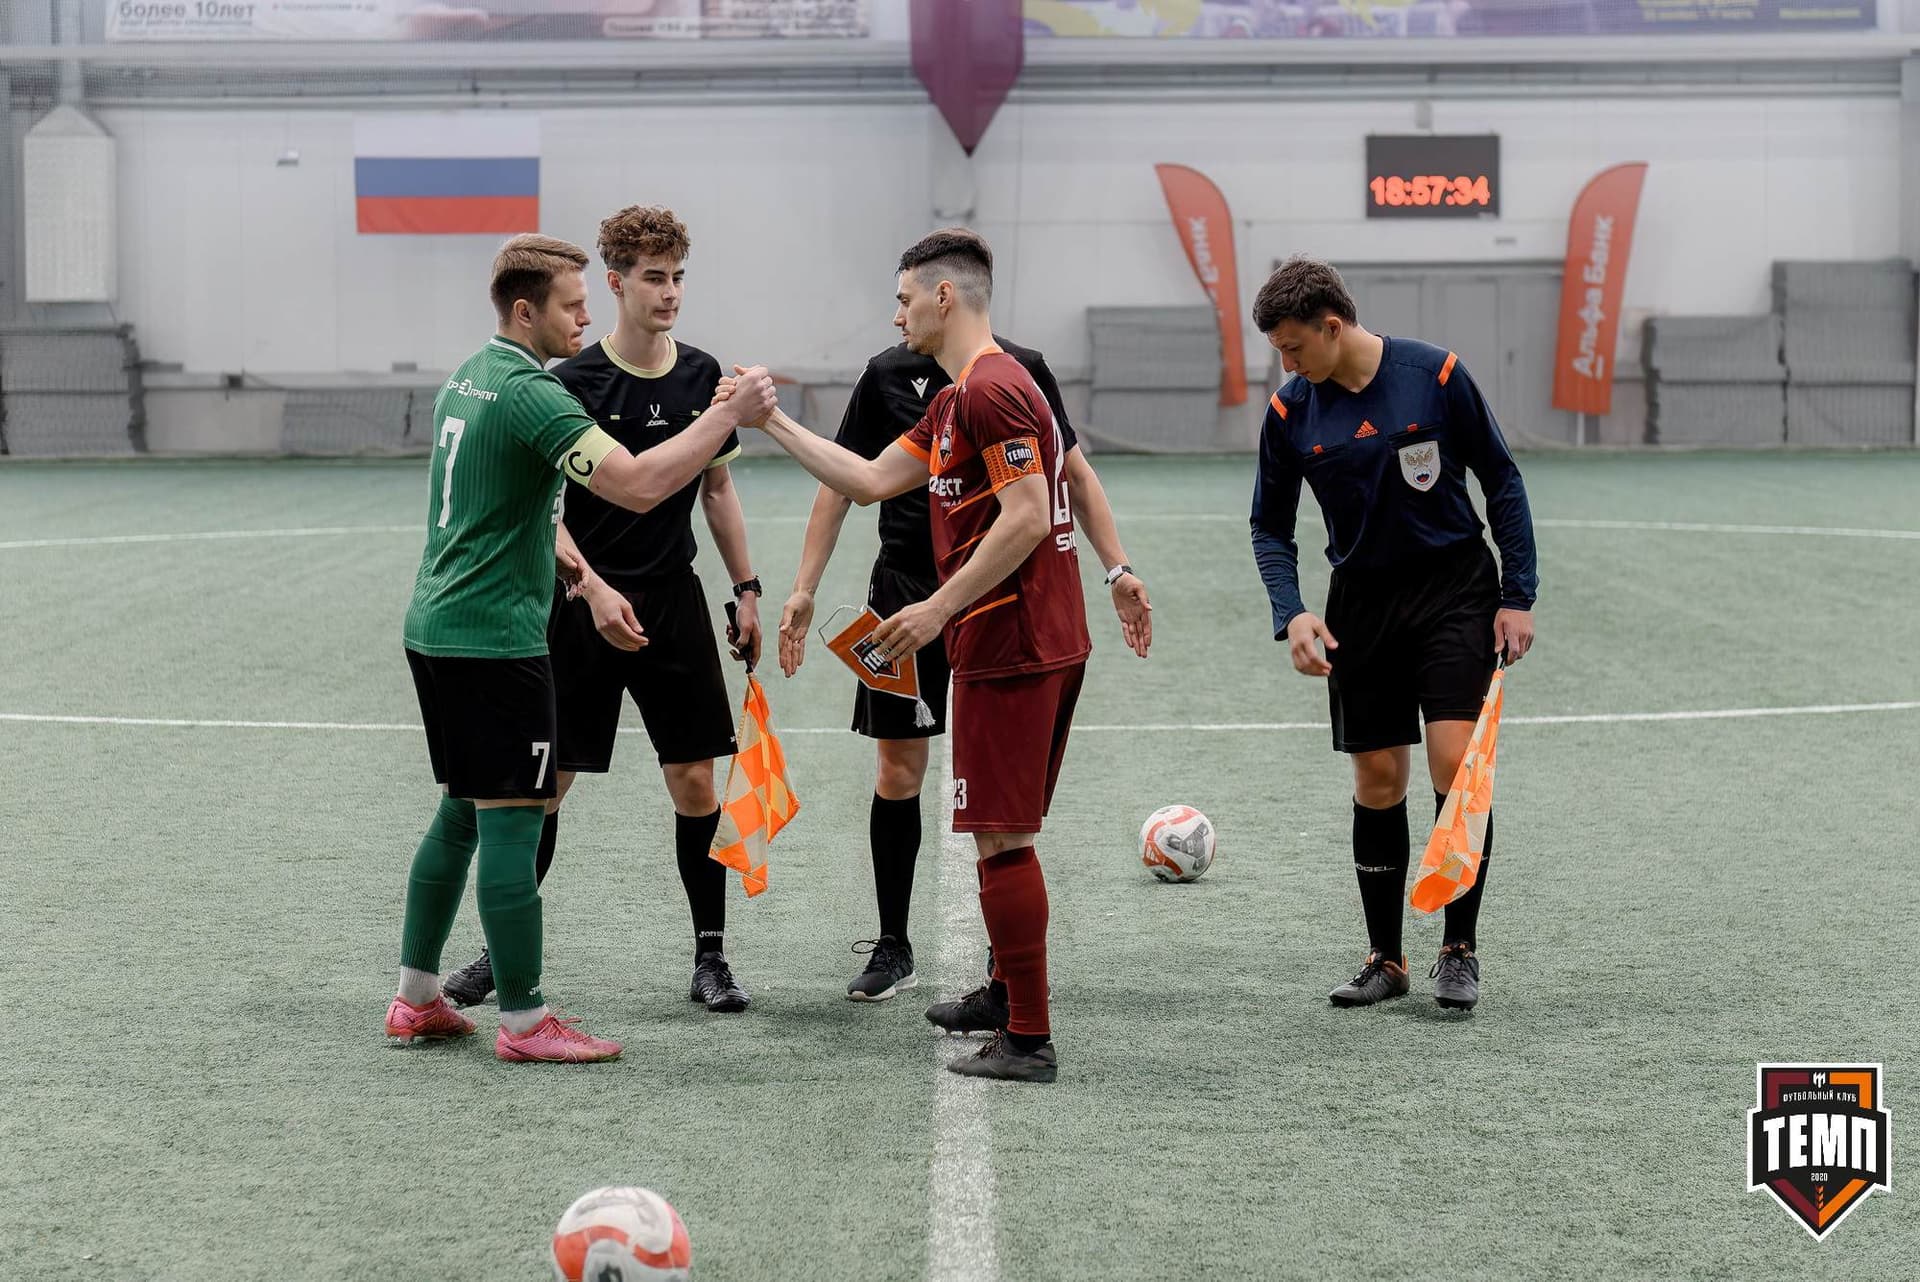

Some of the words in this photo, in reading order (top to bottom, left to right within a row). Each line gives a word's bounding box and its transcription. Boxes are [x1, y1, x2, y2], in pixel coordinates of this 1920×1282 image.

[119, 0, 186, 17] более
[1369, 175, 1491, 206] 18:57:34
[1583, 212, 1614, 285] Банк
[1571, 287, 1606, 381] Альфа
[437, 415, 466, 529] 7
[568, 450, 593, 477] C
[1006, 447, 1033, 463] ТЕМП
[531, 741, 551, 790] 7
